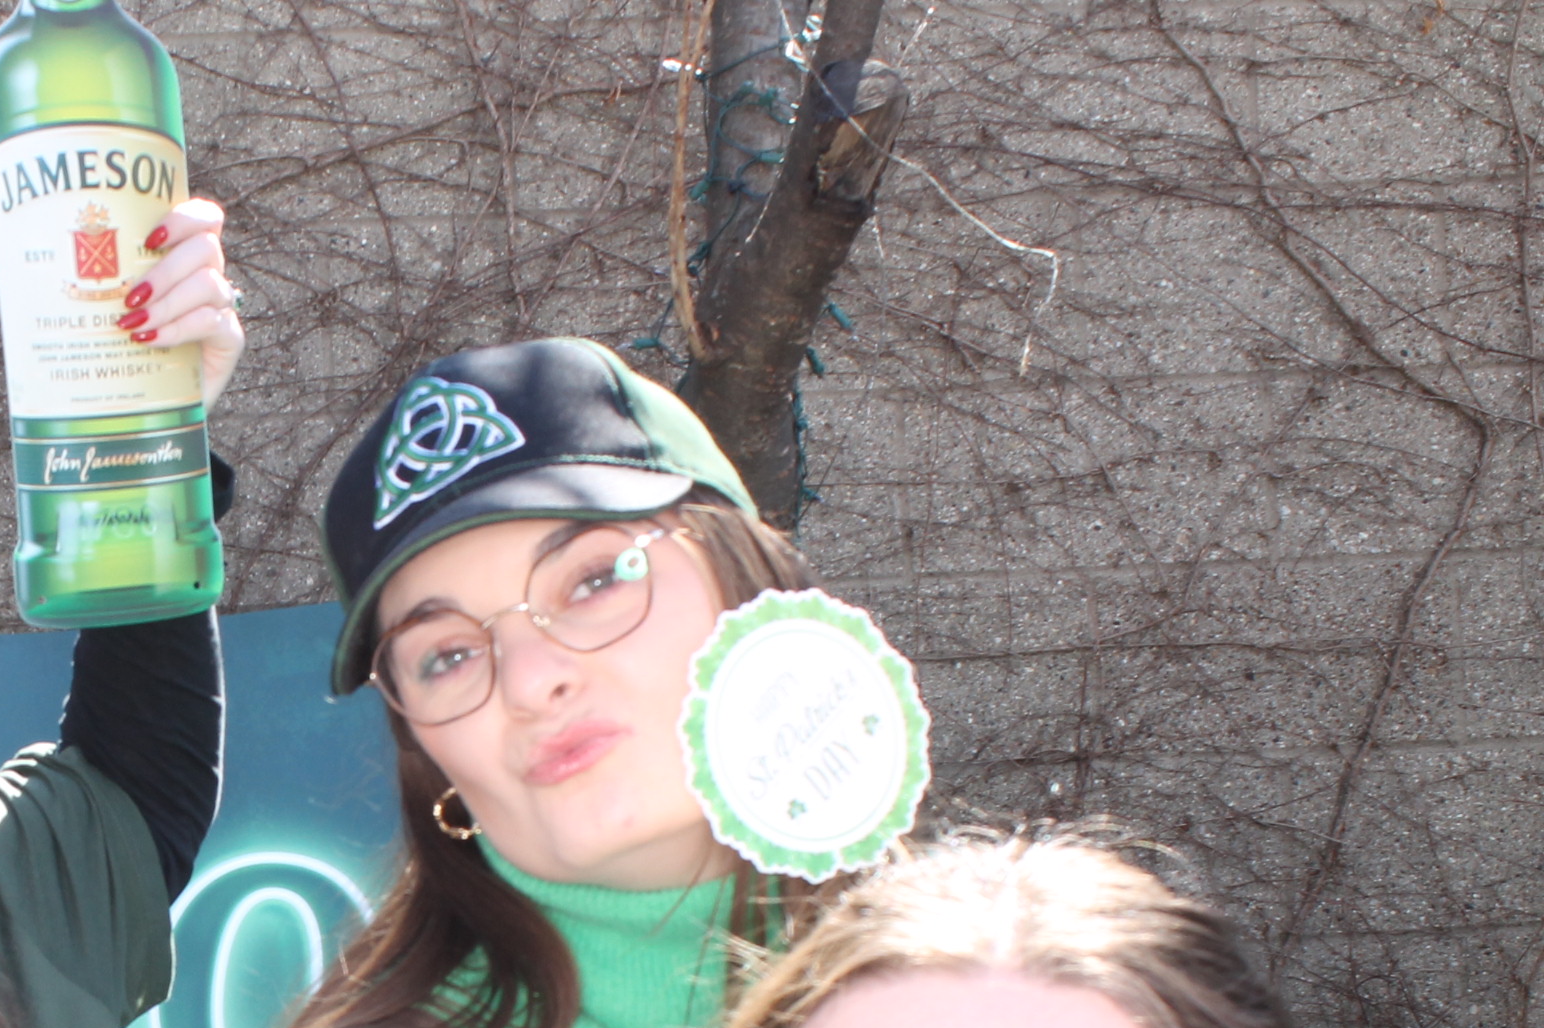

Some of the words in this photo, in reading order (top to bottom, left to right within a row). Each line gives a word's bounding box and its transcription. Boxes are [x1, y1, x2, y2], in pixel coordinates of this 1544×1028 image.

[1, 150, 175, 213] JAMESON
[36, 315, 86, 329] TRIPLE
[50, 368, 90, 381] IRISH
[95, 363, 162, 379] WHISKEY
[44, 447, 81, 484] John
[804, 727, 861, 801] DAY
